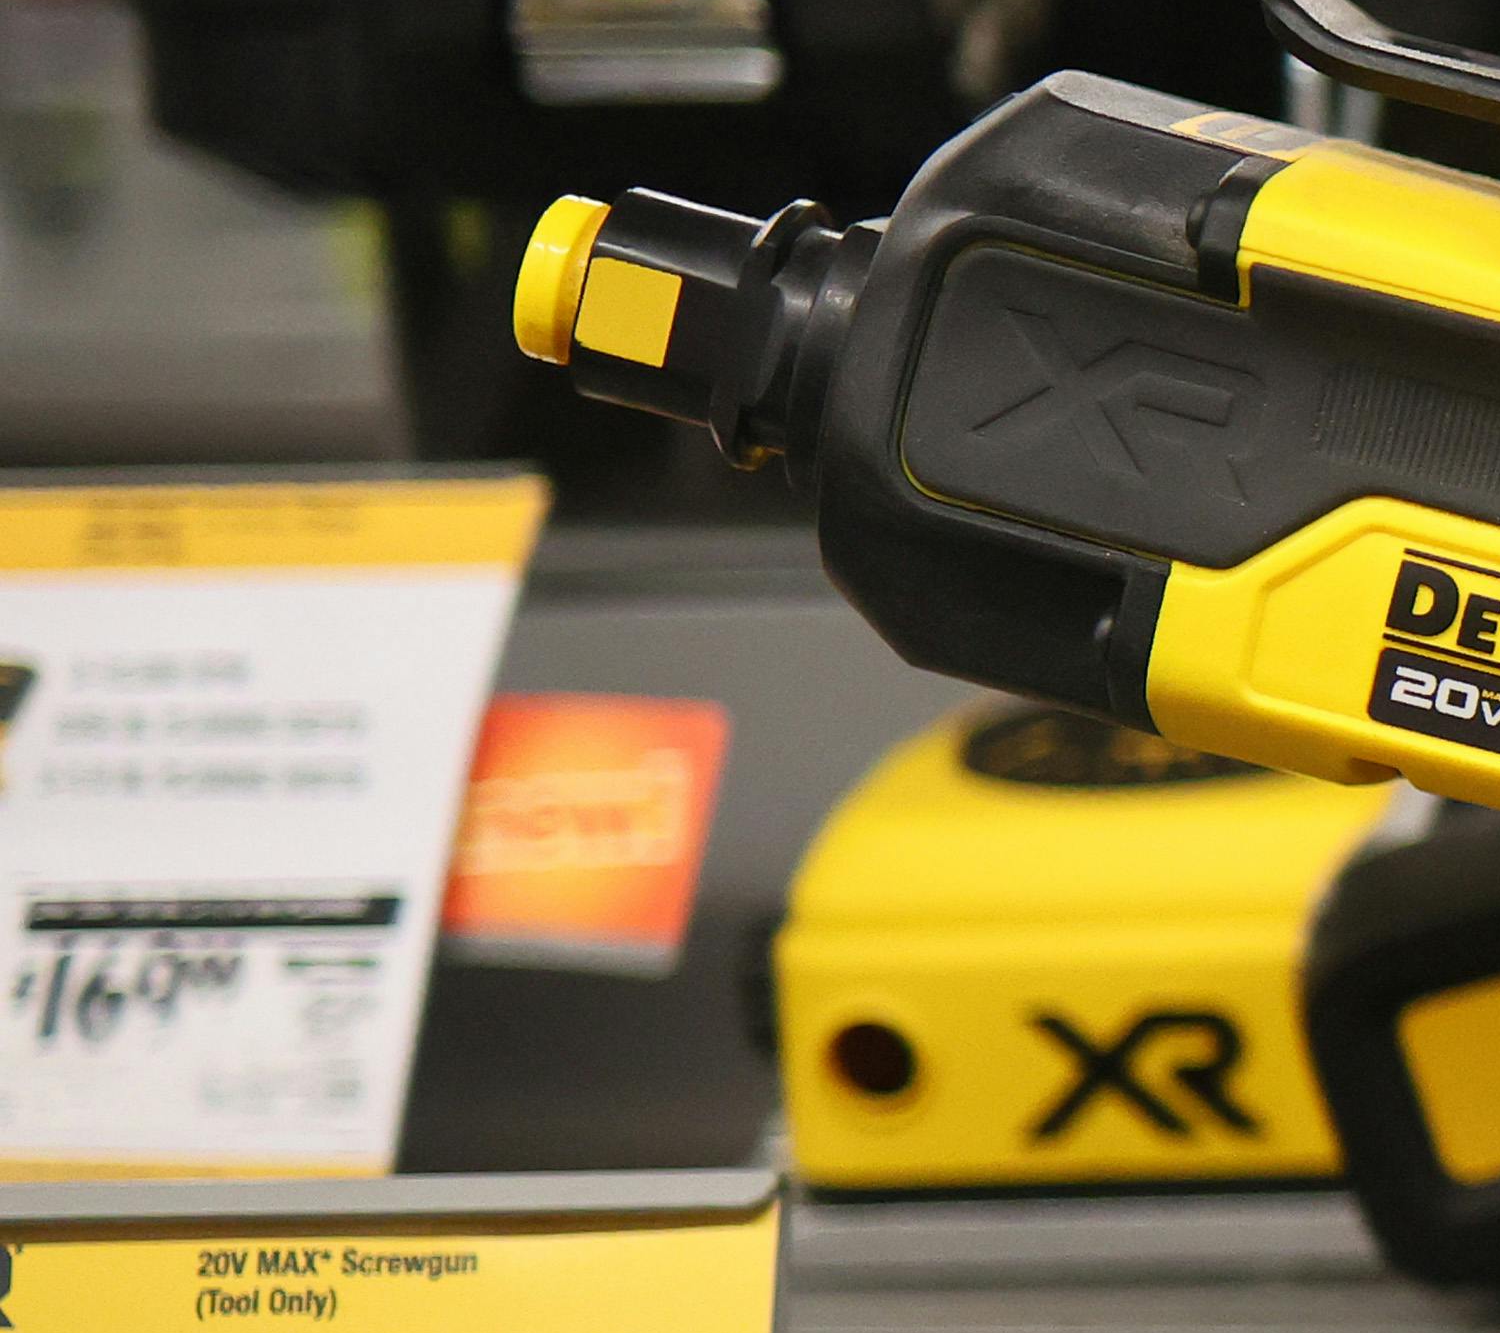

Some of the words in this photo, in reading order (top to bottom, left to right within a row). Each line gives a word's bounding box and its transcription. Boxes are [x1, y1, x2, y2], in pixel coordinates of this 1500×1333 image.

[967, 305, 1267, 507] XR
[1034, 1007, 1262, 1139] XR
[195, 1288, 259, 1321] (Tool
[269, 1287, 337, 1322] Only)
[198, 1250, 248, 1276] 20V
[341, 1249, 478, 1280] Screwgun
